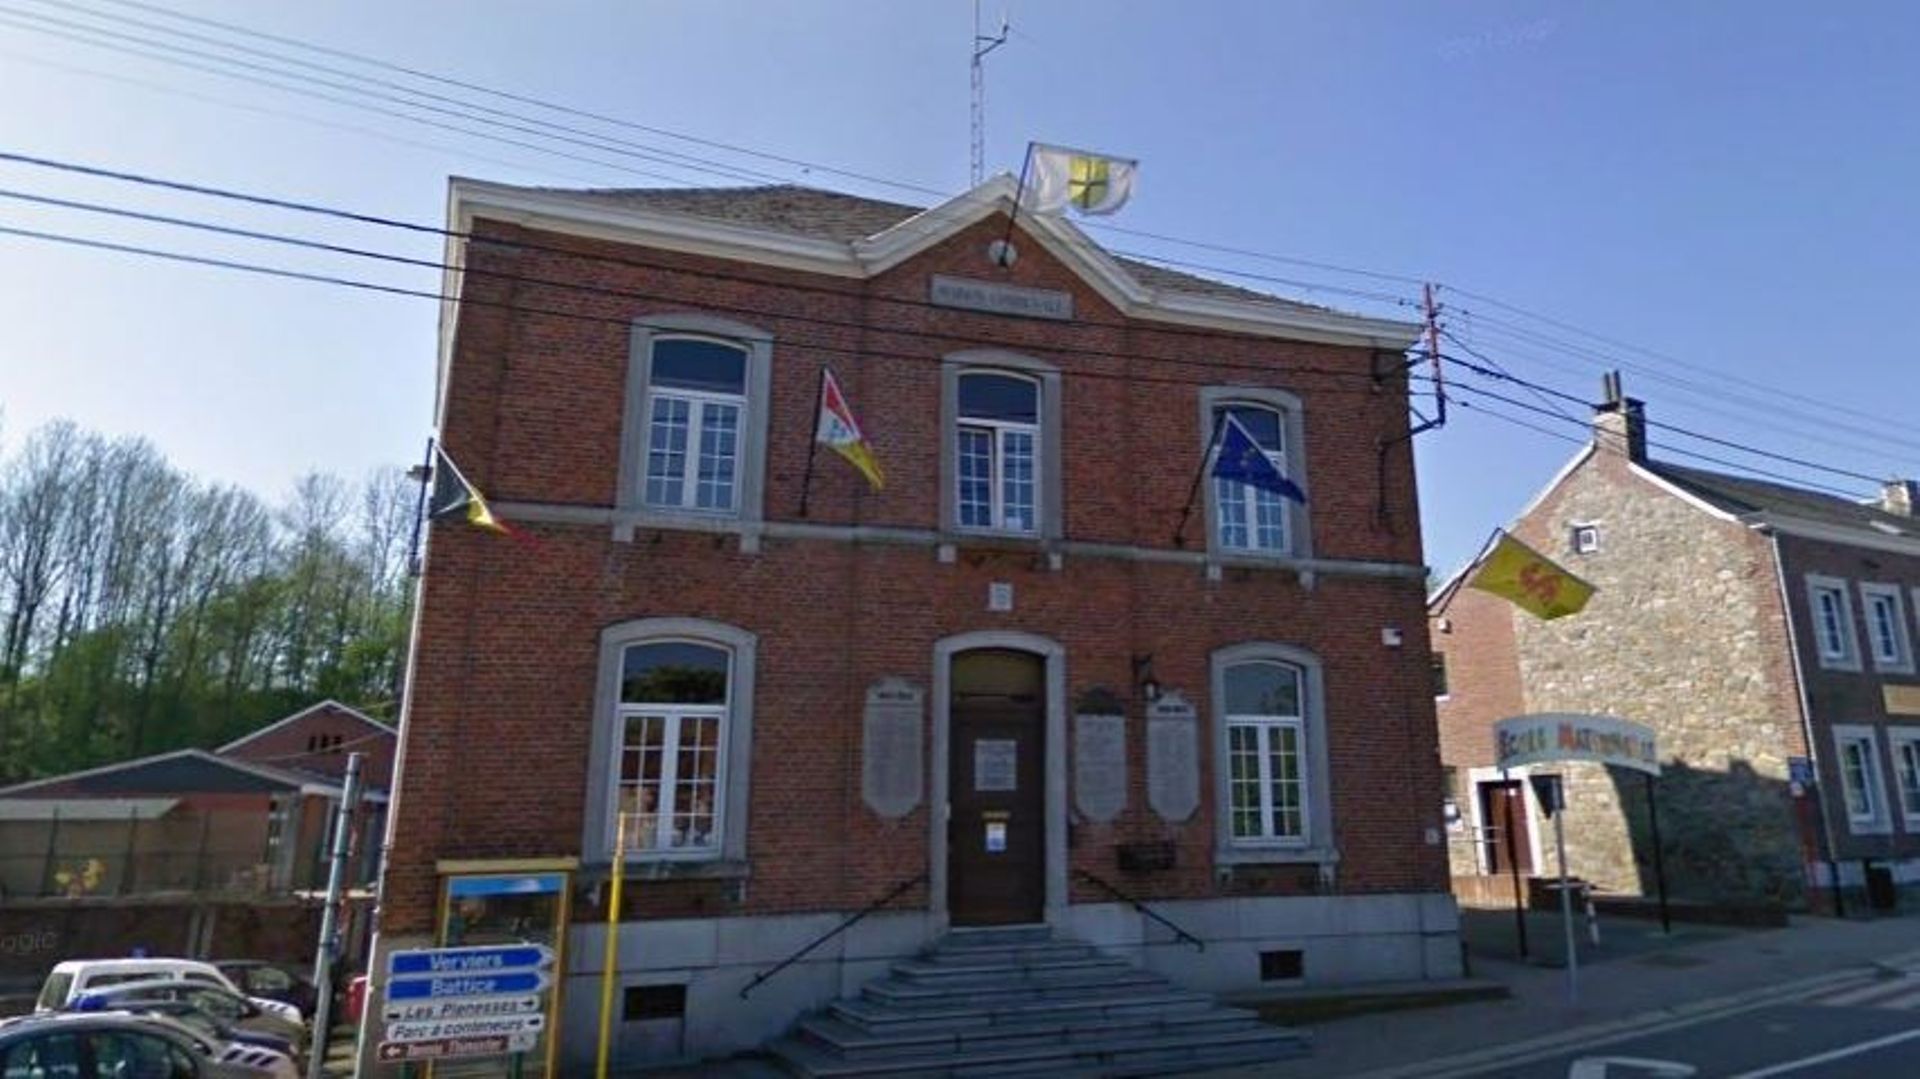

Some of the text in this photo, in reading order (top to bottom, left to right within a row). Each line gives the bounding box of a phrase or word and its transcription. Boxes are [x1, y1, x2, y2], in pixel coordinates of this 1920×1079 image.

[431, 952, 503, 971] Verviers
[431, 977, 497, 995] Battice
[404, 1003, 433, 1019] Les
[394, 1025, 425, 1038] Parc
